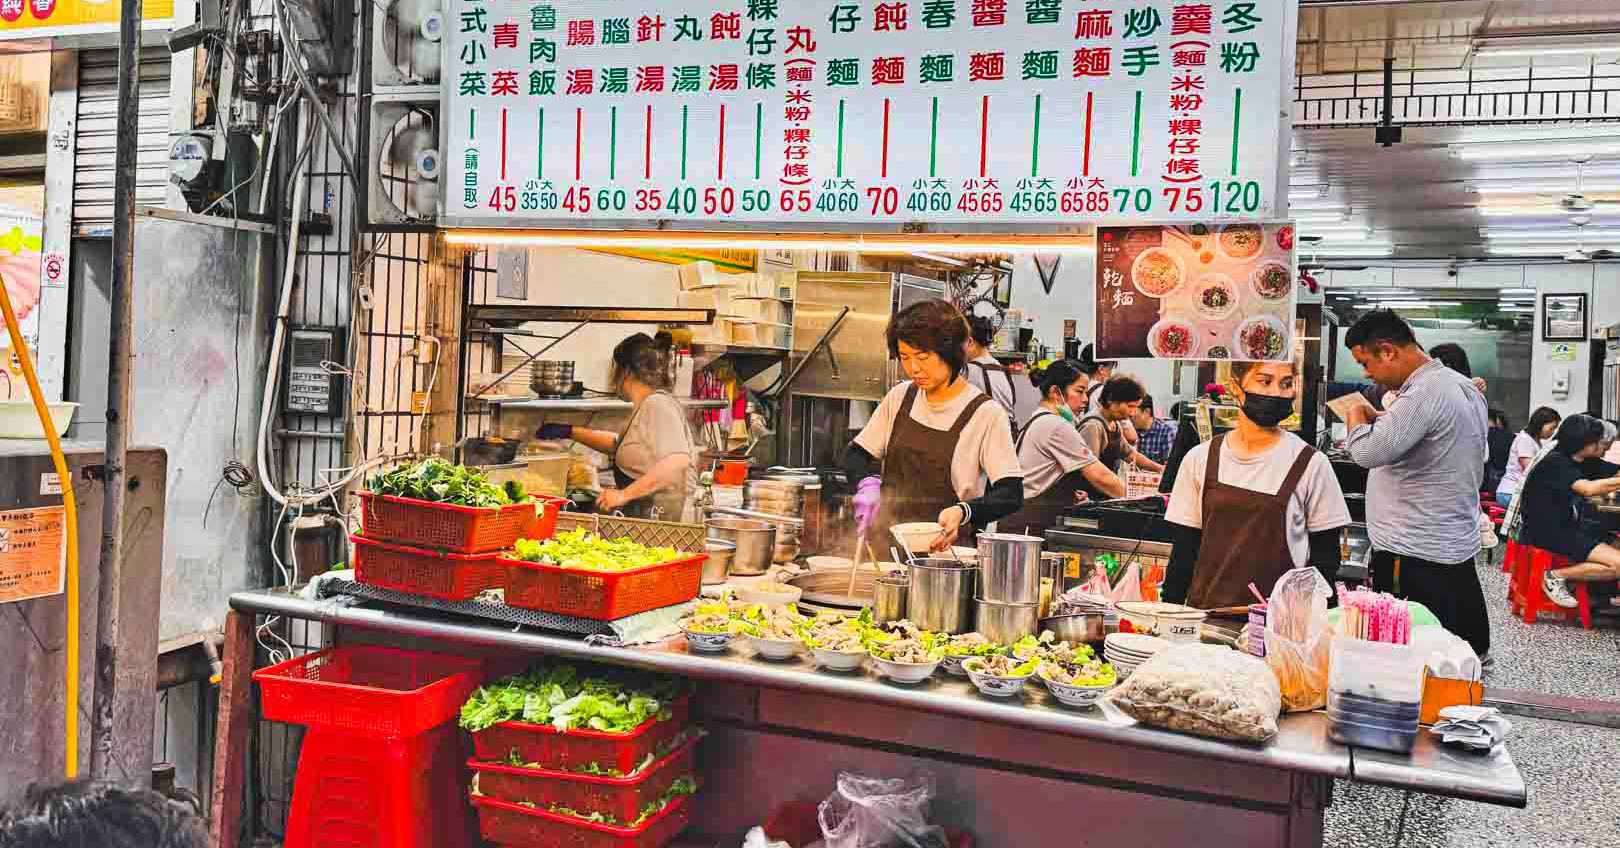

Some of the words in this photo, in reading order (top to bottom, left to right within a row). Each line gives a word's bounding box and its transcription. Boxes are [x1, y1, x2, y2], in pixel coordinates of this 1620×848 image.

[459, 0, 488, 97] 式小菜
[528, 4, 557, 96] 魯肉飯
[708, 11, 741, 91] 飩湯
[745, 0, 779, 90] 粿仔條
[826, 4, 862, 87] 仔麵
[871, 1, 908, 86] 飩麵
[919, 0, 956, 84] 春麵
[969, 0, 1008, 82] 醬麵
[1021, 0, 1063, 81] 醬麵
[1072, 0, 1113, 78] 麻麵
[1120, 6, 1162, 77] 炒手
[1219, 2, 1263, 74] 冬粉
[491, 22, 520, 96] 青菜
[565, 19, 595, 96] 腸湯
[599, 17, 630, 94] 腦湯
[635, 14, 667, 93] 針湯
[671, 14, 703, 93] 丸湯
[525, 181, 539, 190] 小
[540, 180, 553, 190] 大
[823, 180, 837, 190] 小
[840, 179, 855, 190] 大
[911, 179, 928, 190] 小
[931, 178, 946, 190] 大
[963, 179, 979, 190] 小
[983, 178, 998, 190] 大
[1015, 178, 1033, 190] 小
[1037, 177, 1053, 190] 大
[1067, 177, 1085, 190] 小
[1087, 176, 1105, 190] 大
[1209, 180, 1260, 213] 120
[488, 185, 516, 212] 45
[521, 192, 538, 210] 35
[540, 192, 558, 210] 50
[562, 186, 591, 213] 45
[597, 189, 626, 211] 60
[635, 189, 662, 211] 35
[666, 187, 697, 215] 40
[703, 187, 735, 215] 50
[742, 189, 771, 212] 50
[780, 189, 811, 212] 65
[815, 192, 837, 212] 40
[838, 192, 859, 212] 60
[866, 186, 898, 216] 70
[906, 192, 928, 212] 40
[930, 191, 952, 212] 60
[956, 192, 979, 213] 45
[980, 192, 1003, 213] 65
[1009, 191, 1032, 213] 45
[1034, 191, 1057, 213] 65
[1060, 191, 1084, 213] 65
[1085, 191, 1109, 212] 85
[1113, 187, 1152, 213] 70
[1163, 187, 1203, 213] 75
